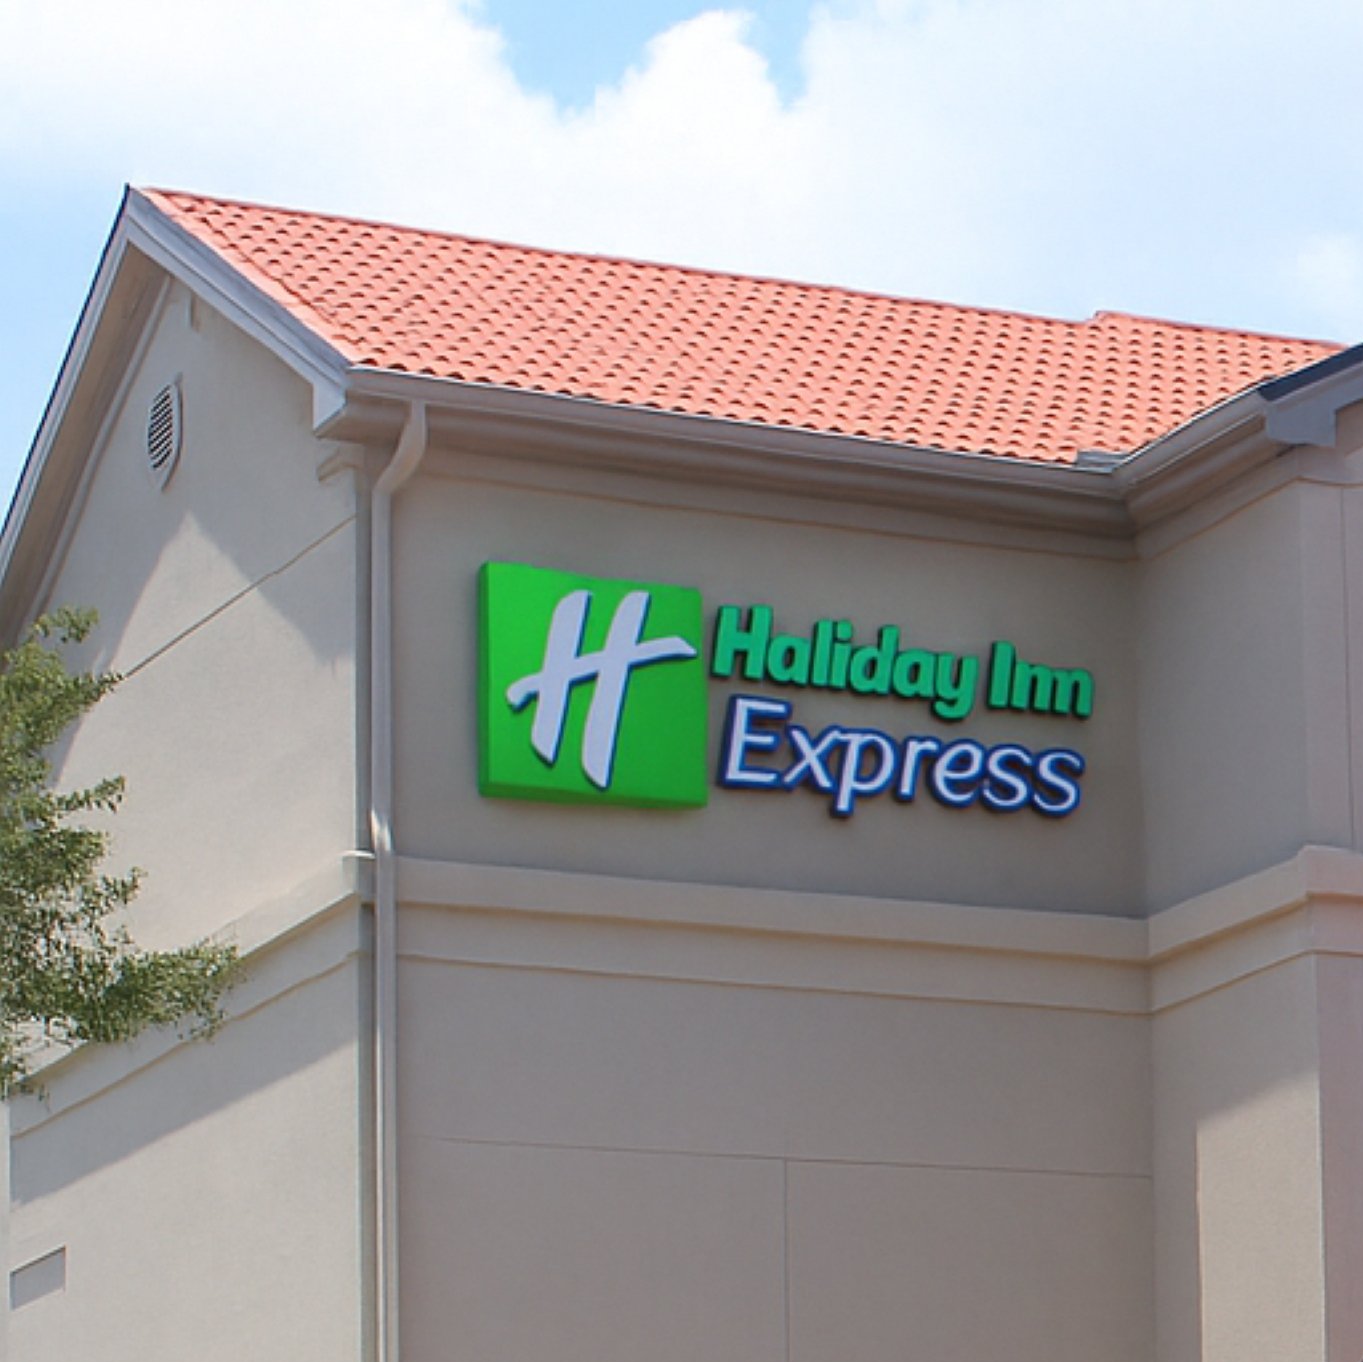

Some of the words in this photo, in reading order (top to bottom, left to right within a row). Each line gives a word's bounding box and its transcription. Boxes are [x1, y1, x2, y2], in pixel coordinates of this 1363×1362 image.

[505, 589, 697, 790] H
[987, 640, 1094, 719] Inn
[718, 694, 1087, 820] Express
